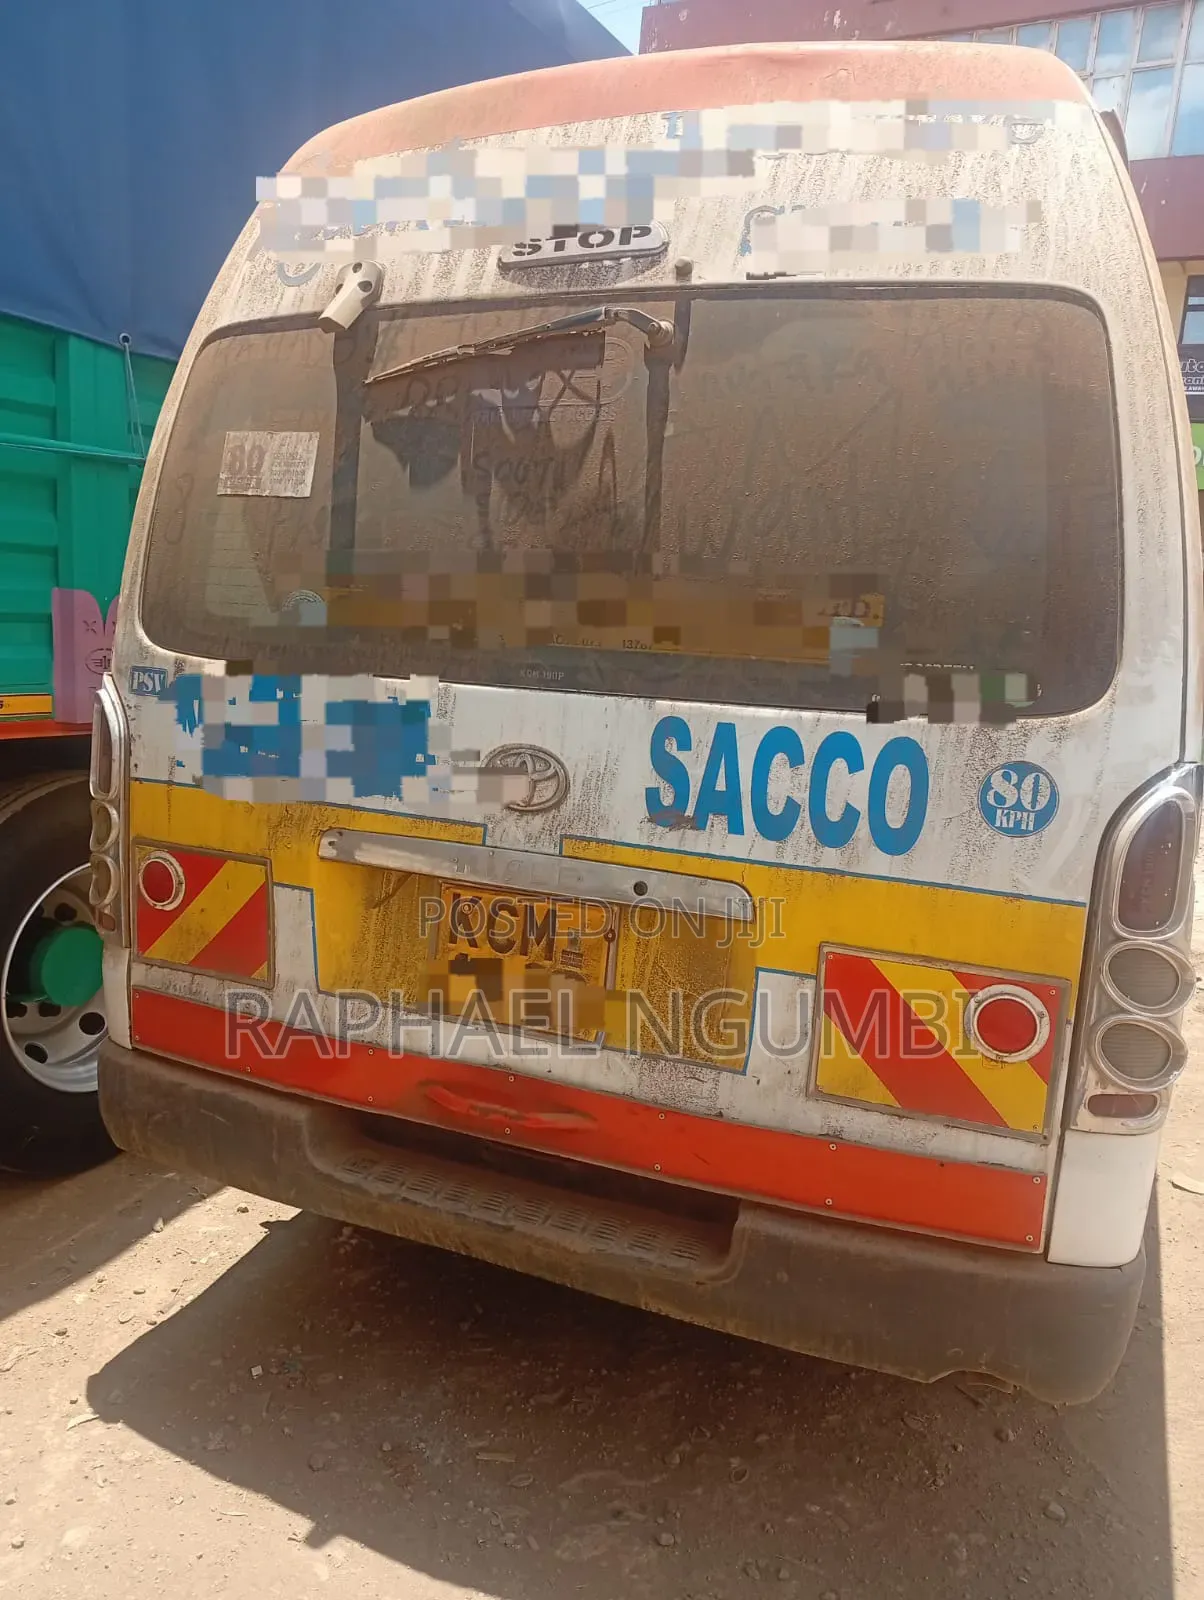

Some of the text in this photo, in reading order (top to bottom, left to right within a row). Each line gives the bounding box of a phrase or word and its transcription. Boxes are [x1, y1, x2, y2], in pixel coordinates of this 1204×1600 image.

[511, 223, 653, 257] STOP
[132, 671, 166, 693] PSV
[645, 715, 930, 856] SACCO
[986, 769, 1051, 812] 80
[994, 808, 1036, 831] KPH
[448, 891, 557, 962] KCM
